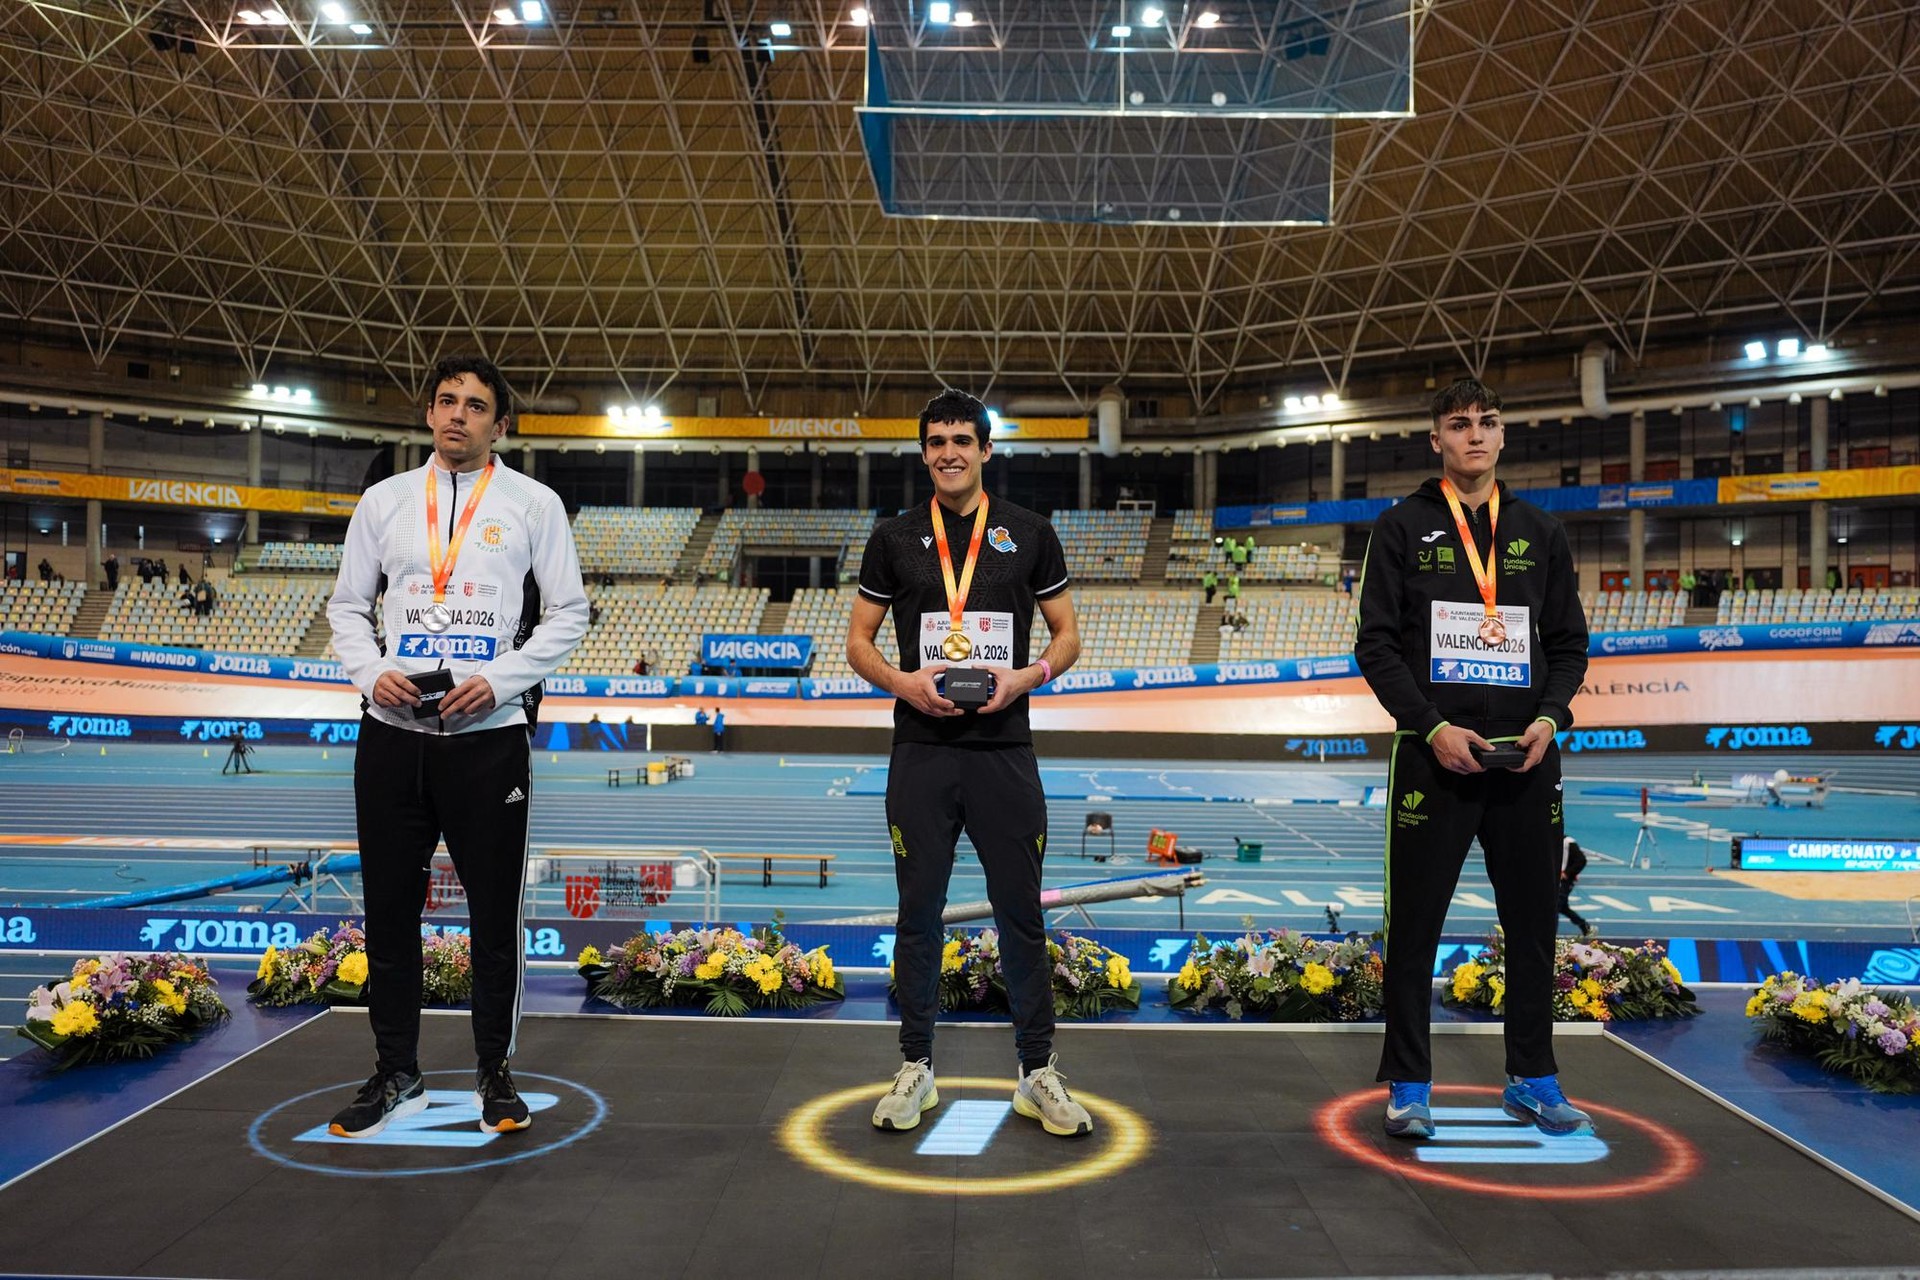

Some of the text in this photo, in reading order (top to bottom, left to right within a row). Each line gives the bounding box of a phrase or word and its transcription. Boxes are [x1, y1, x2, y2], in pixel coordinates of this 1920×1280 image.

[769, 418, 862, 437] VALENCIA
[129, 480, 242, 506] VALENCIA
[466, 610, 495, 627] 2026
[1769, 627, 1843, 638] GOODFORM
[709, 641, 802, 660] VALENCIA
[984, 645, 1008, 661] 2026
[141, 652, 196, 667] MONDO
[1787, 843, 1895, 860] CAMPEONATO
